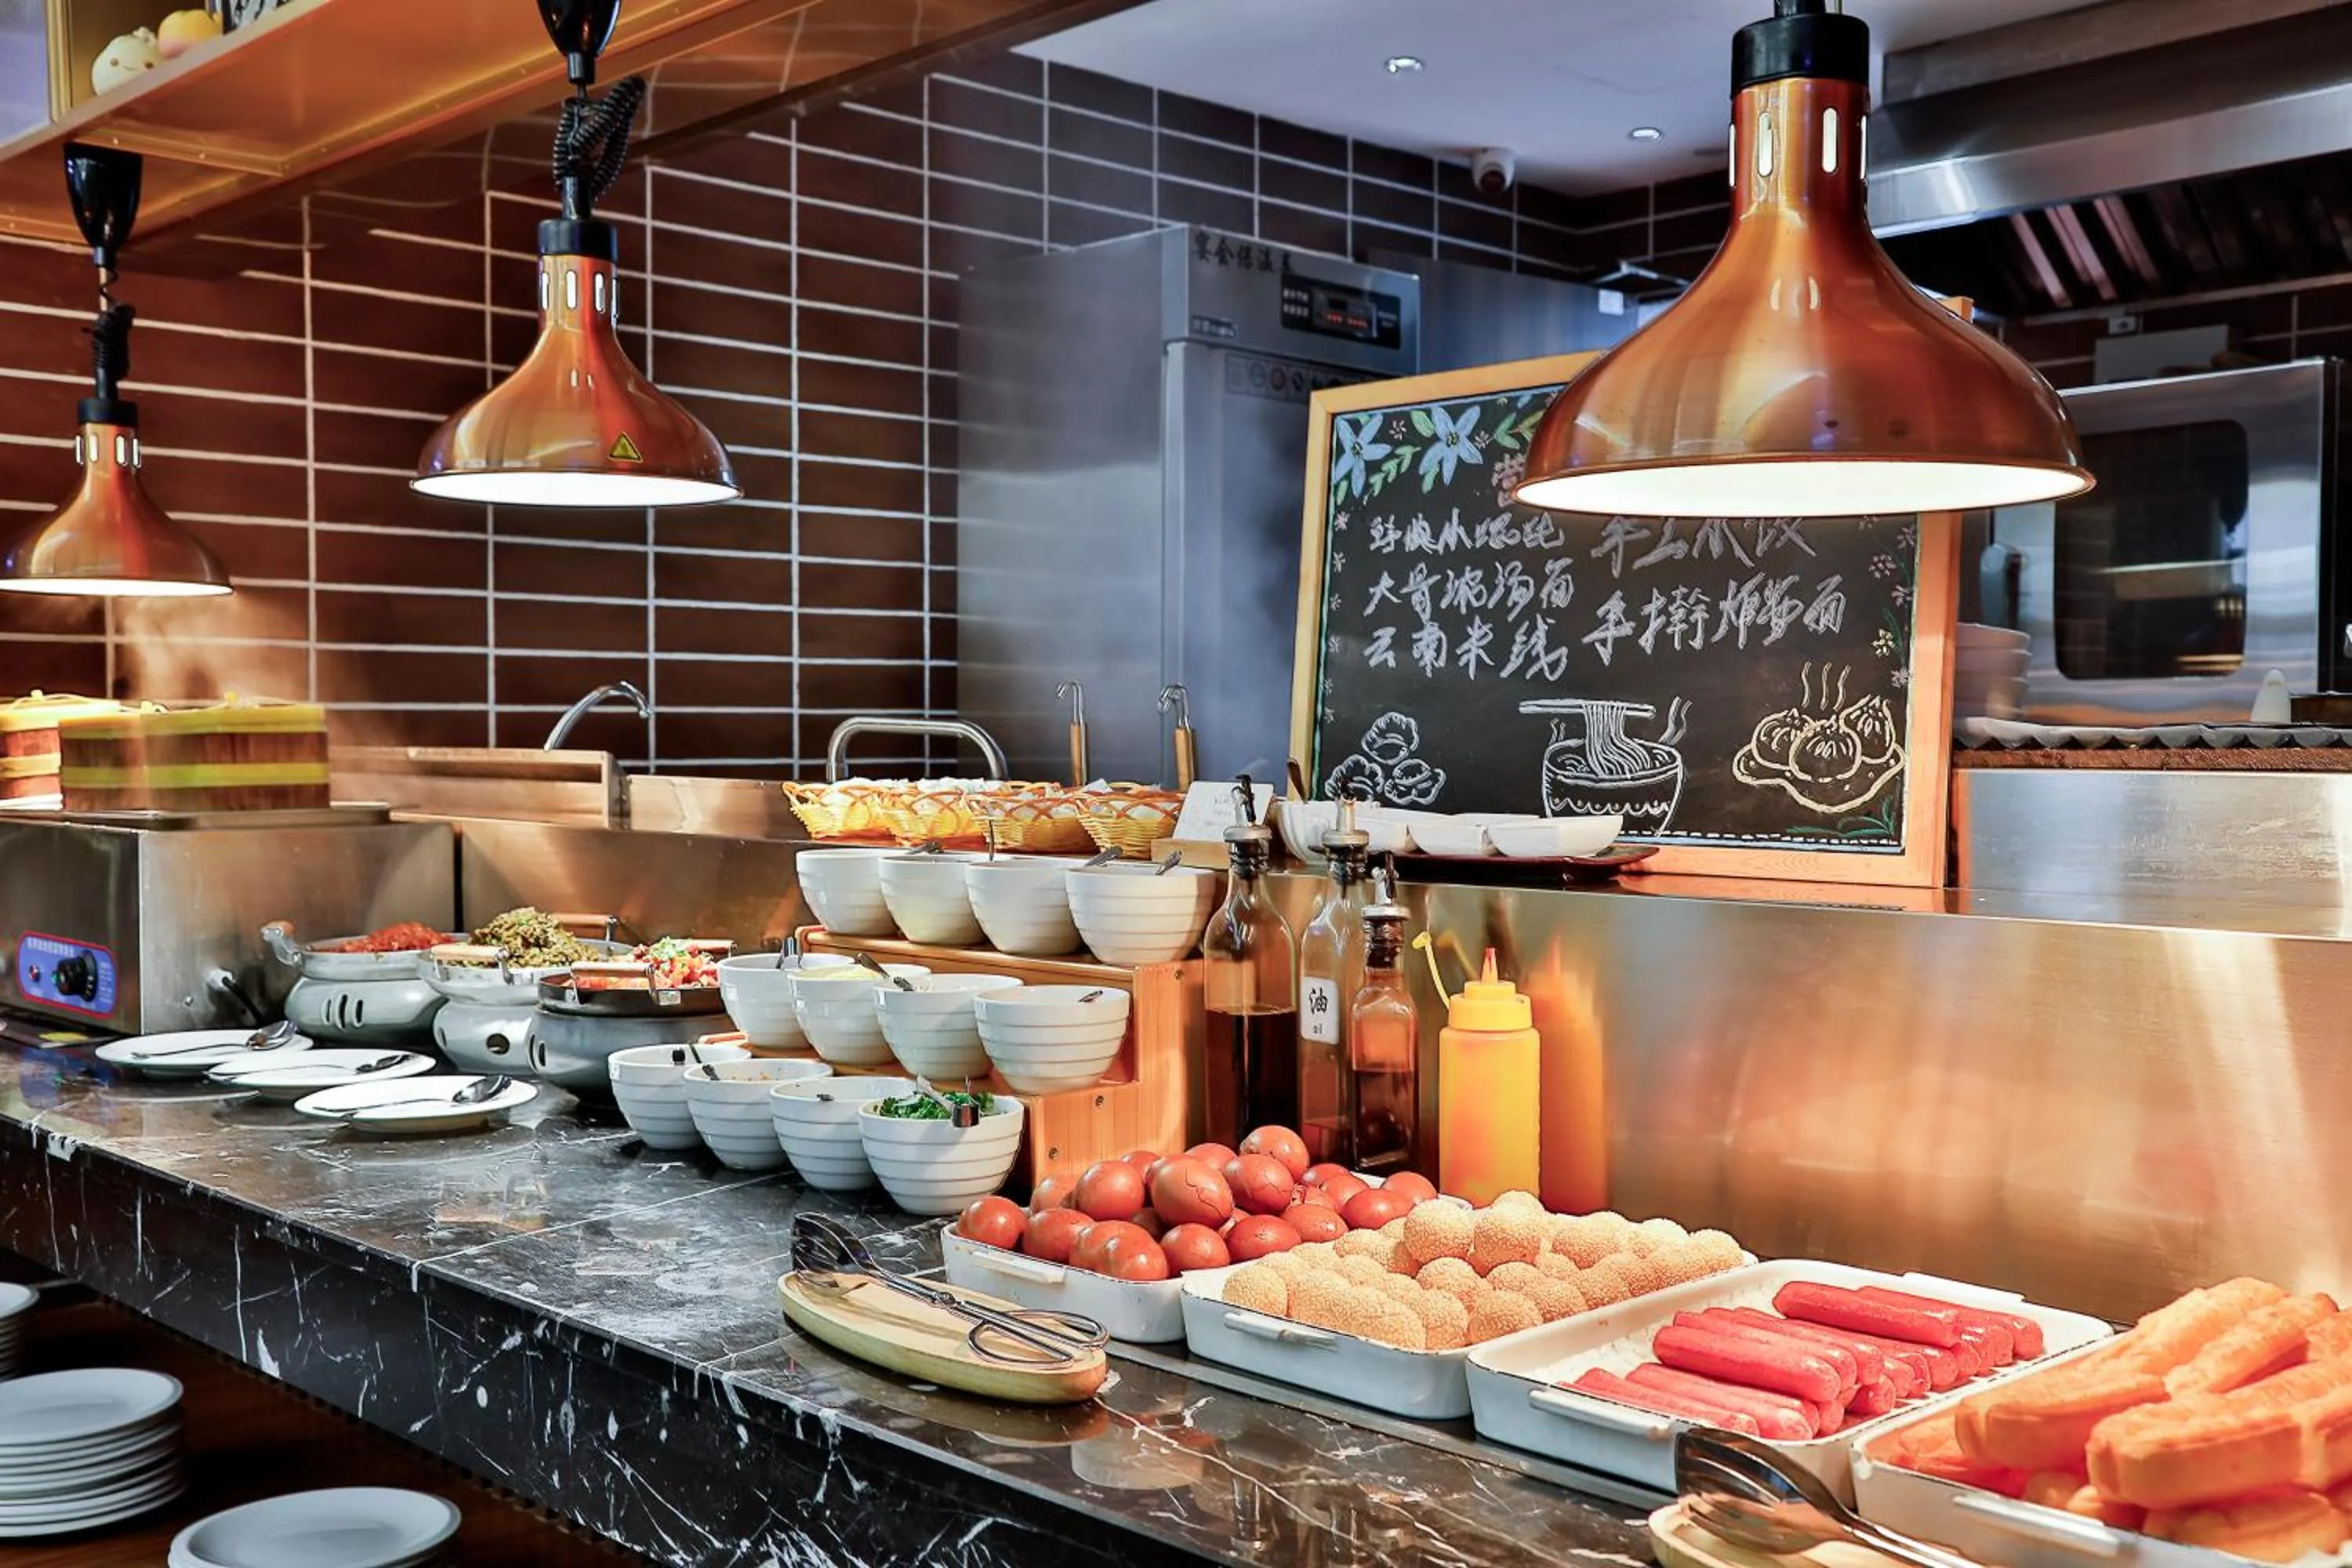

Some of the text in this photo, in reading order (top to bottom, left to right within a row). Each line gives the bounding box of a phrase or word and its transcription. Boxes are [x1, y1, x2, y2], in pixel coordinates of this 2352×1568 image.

[1363, 613, 1569, 681] 云南米线
[1308, 986, 1328, 1015] 油
